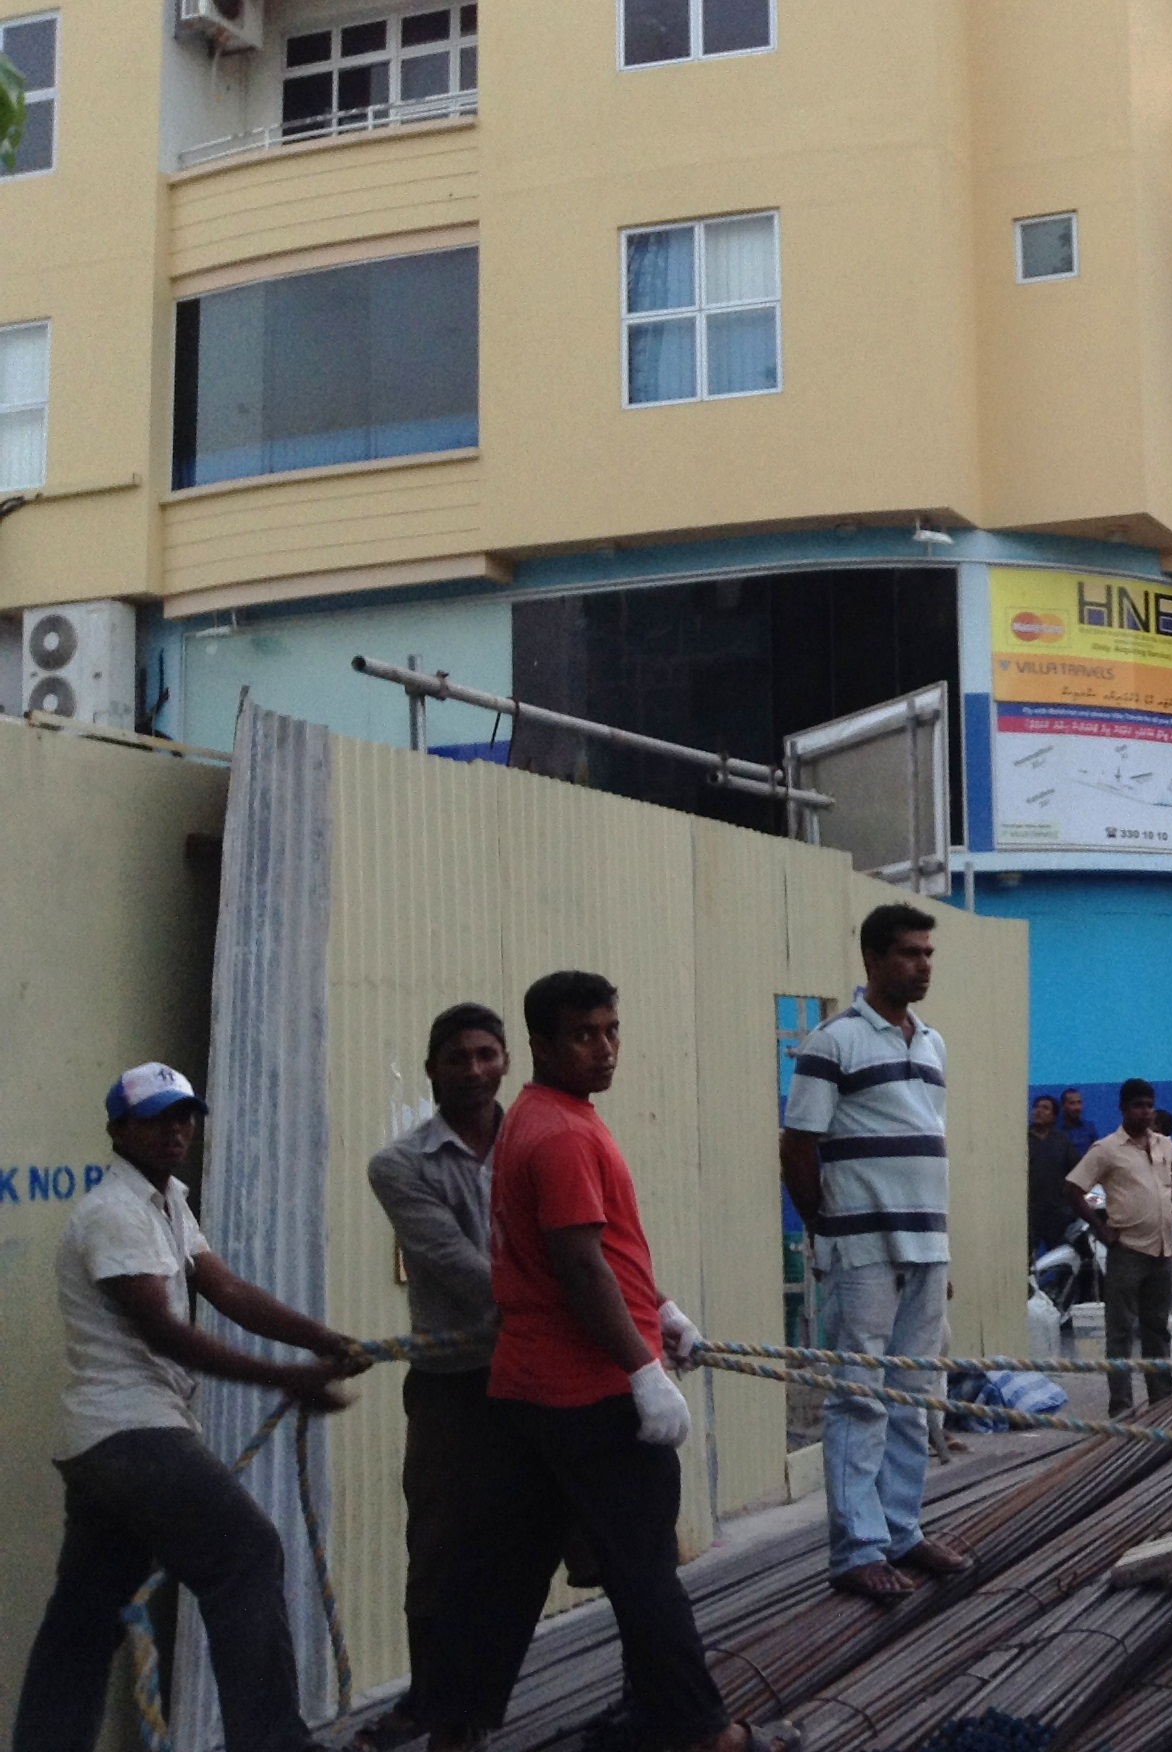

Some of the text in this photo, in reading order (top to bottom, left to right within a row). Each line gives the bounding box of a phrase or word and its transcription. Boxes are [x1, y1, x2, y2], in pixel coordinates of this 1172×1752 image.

[1016, 661, 1115, 681] VILLA TRAVELS
[1120, 829, 1168, 841] 330 10 10
[29, 1165, 76, 1201] NO
[84, 1164, 111, 1195] P
